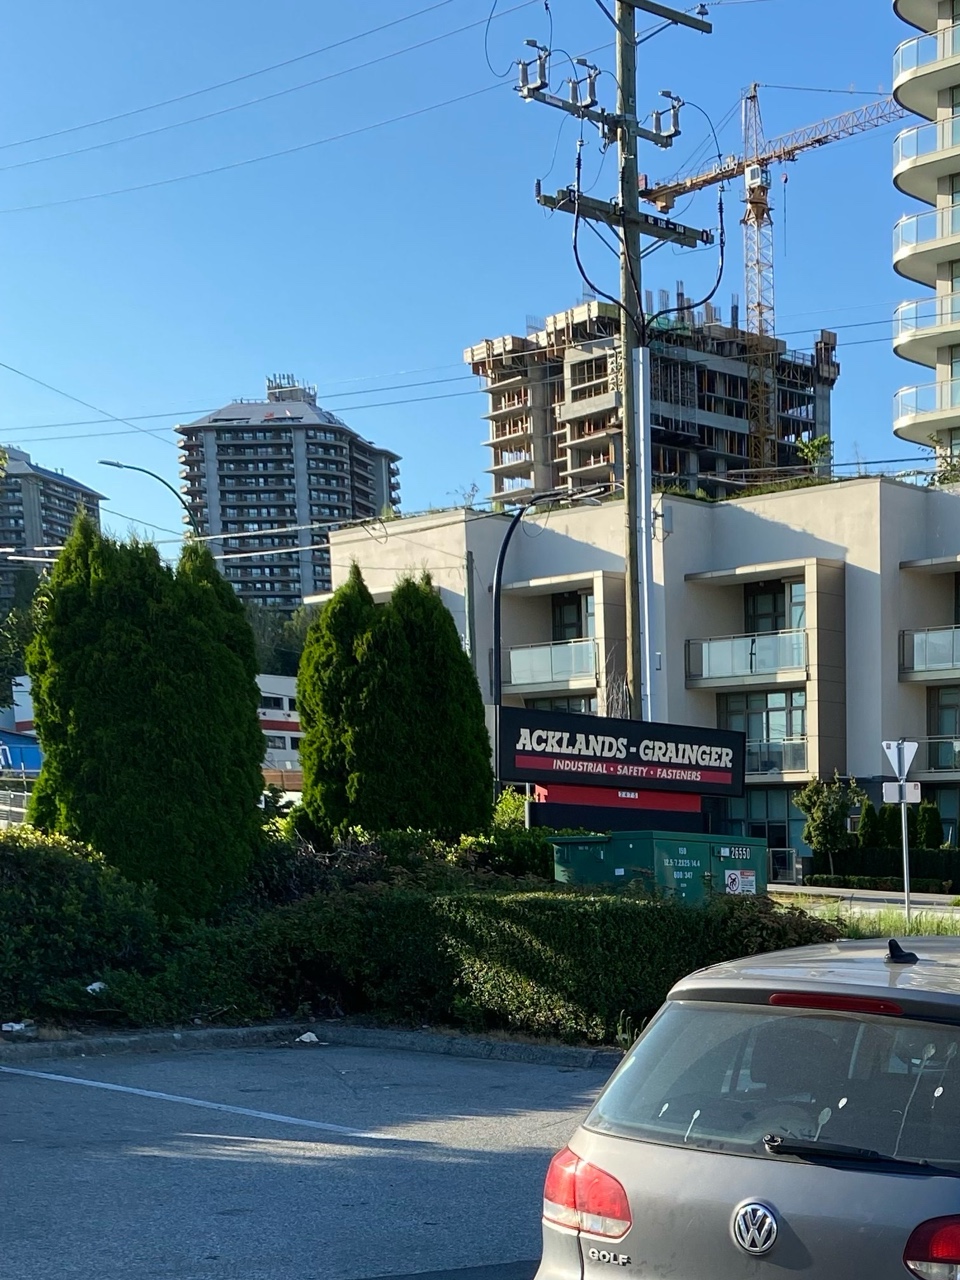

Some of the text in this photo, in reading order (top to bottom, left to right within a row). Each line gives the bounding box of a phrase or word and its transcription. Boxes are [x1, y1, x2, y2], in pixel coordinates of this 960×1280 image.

[553, 759, 701, 781] INDUSTRIAL SAFETY FASTENERS
[731, 847, 750, 859] 26550
[588, 1247, 629, 1266] GOLF
